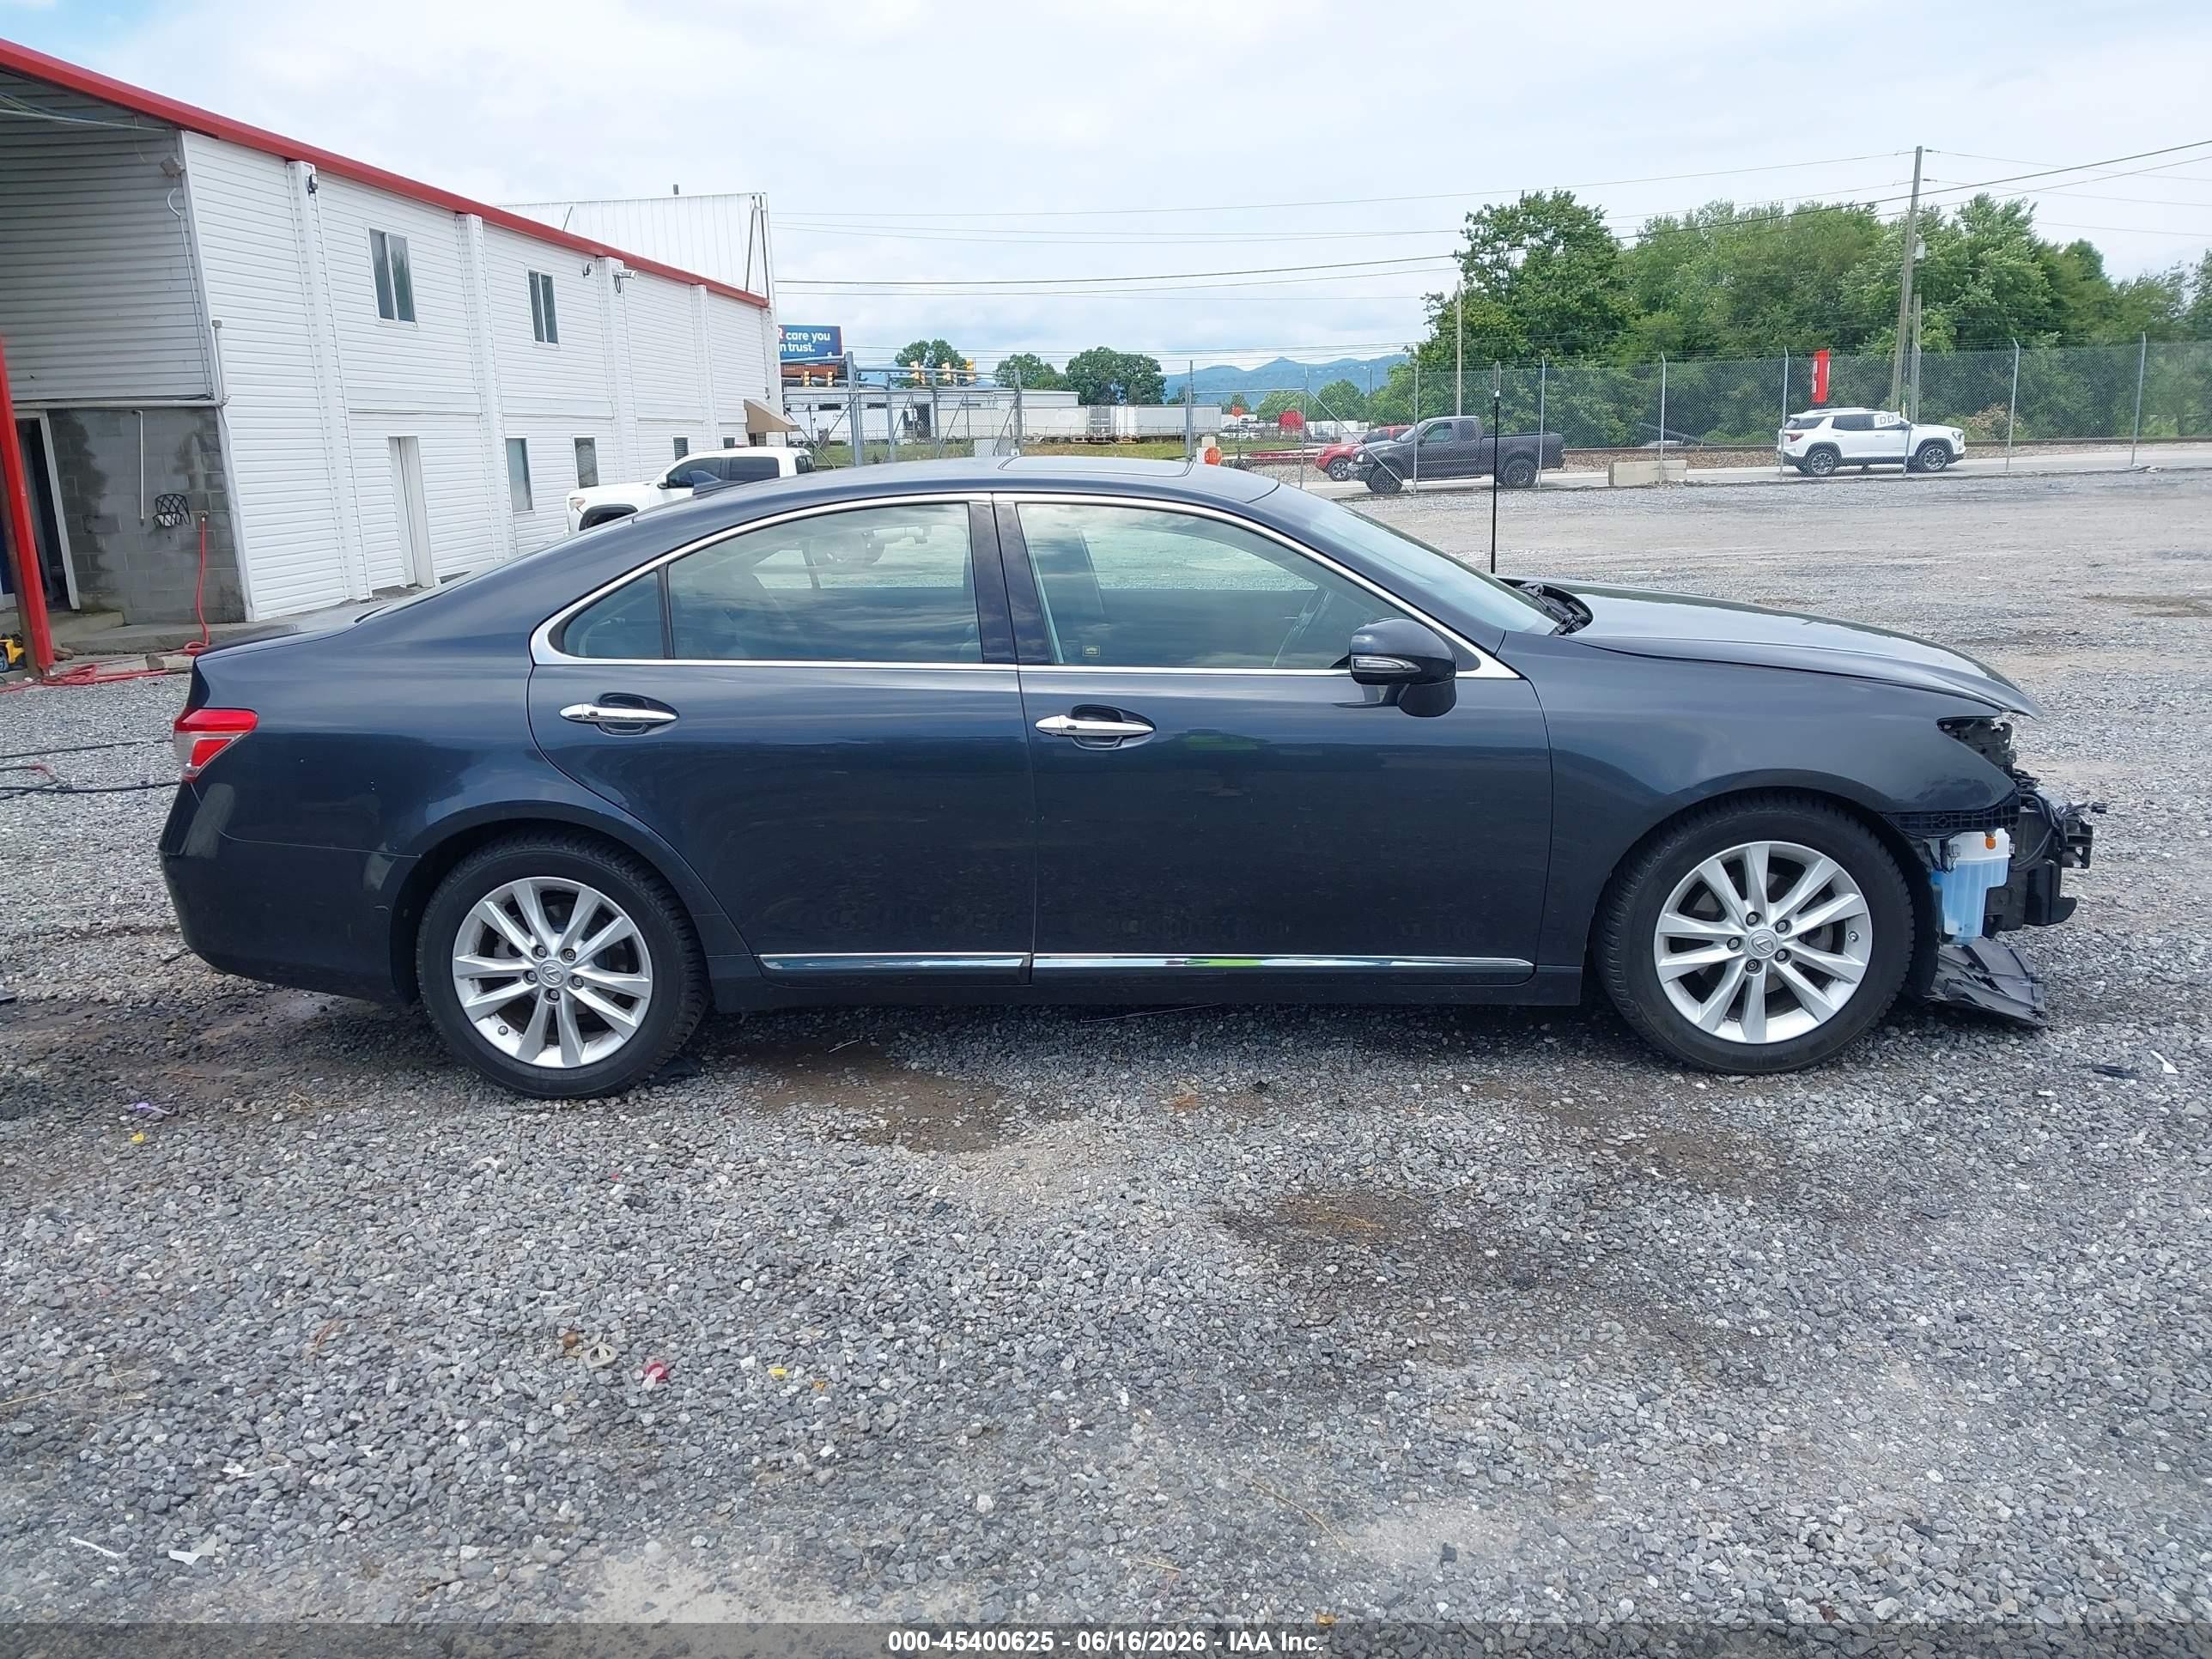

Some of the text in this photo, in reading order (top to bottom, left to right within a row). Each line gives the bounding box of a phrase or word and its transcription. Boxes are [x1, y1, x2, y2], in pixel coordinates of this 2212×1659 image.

[786, 331, 809, 341] care
[811, 331, 831, 344] you
[787, 342, 816, 353] trust.
[1205, 452, 1222, 461] STOP
